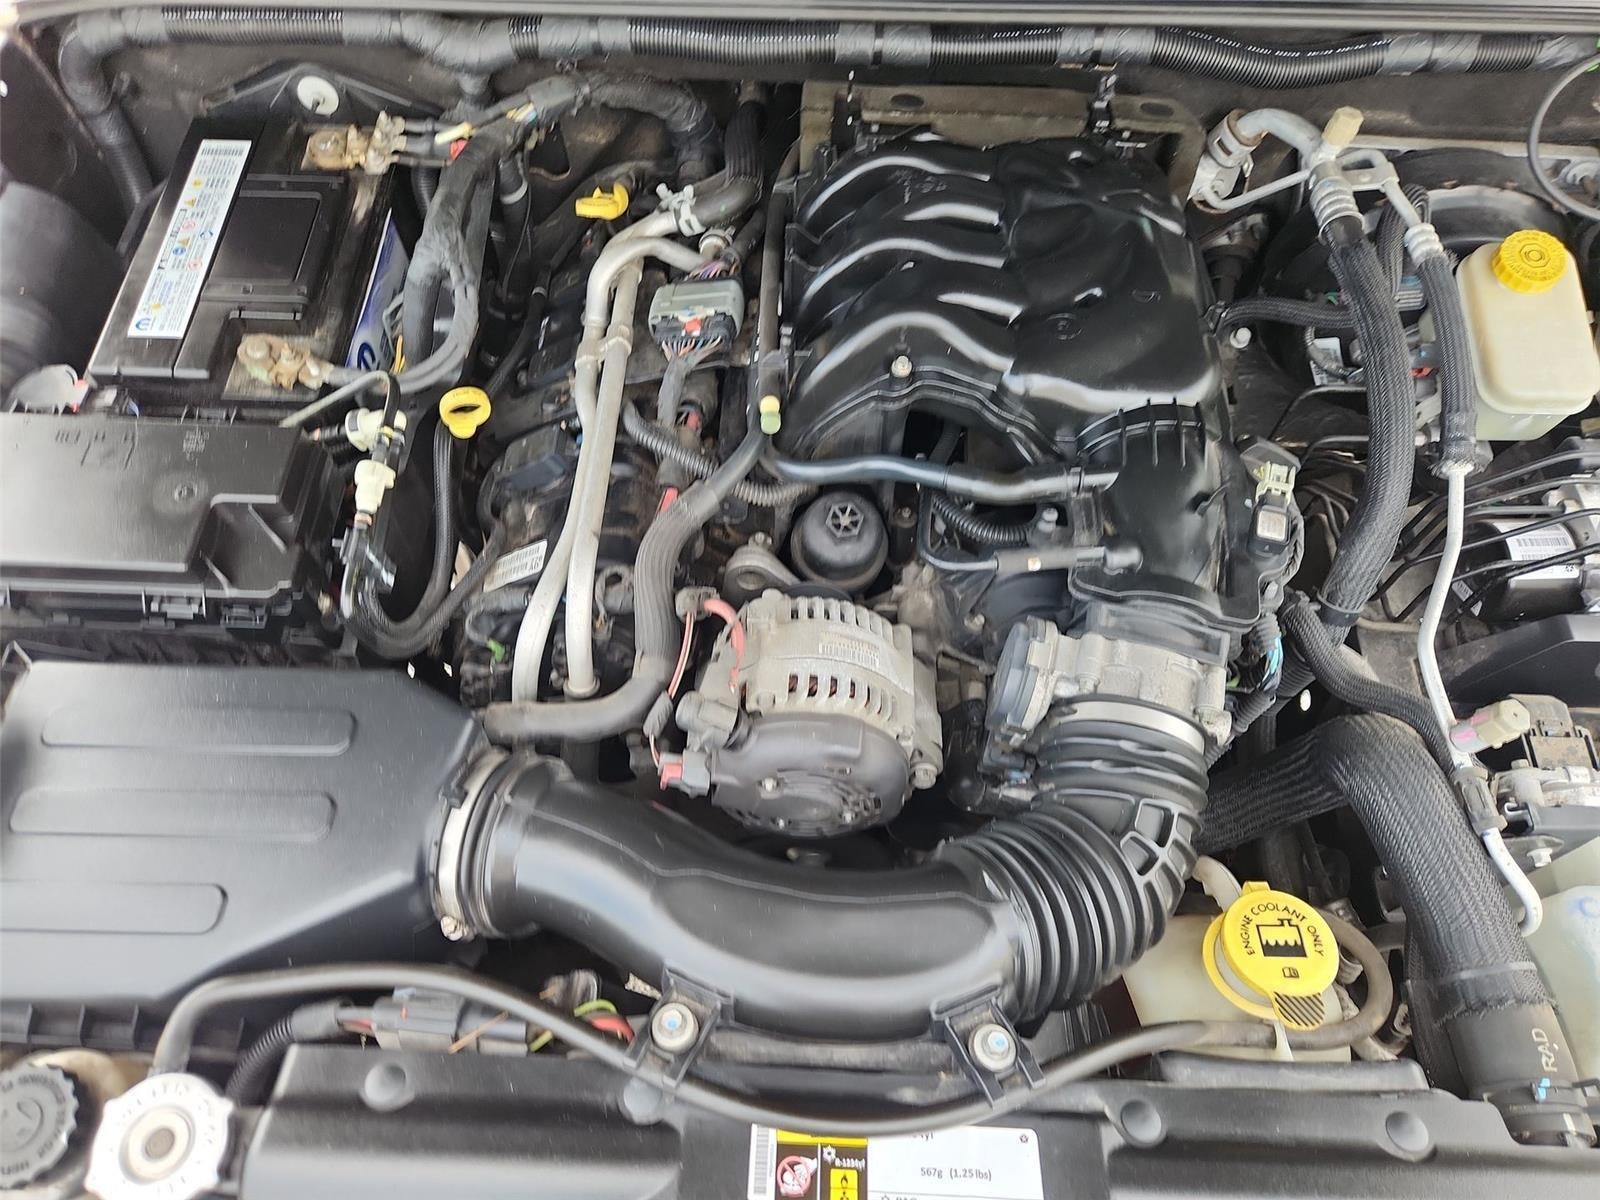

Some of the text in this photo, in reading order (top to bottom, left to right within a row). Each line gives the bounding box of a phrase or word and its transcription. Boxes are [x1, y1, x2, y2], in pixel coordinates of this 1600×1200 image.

[1240, 902, 1325, 957] ENGINE COOLANT ONLY
[1531, 1028, 1558, 1072] RAD
[920, 1166, 943, 1179] 567g
